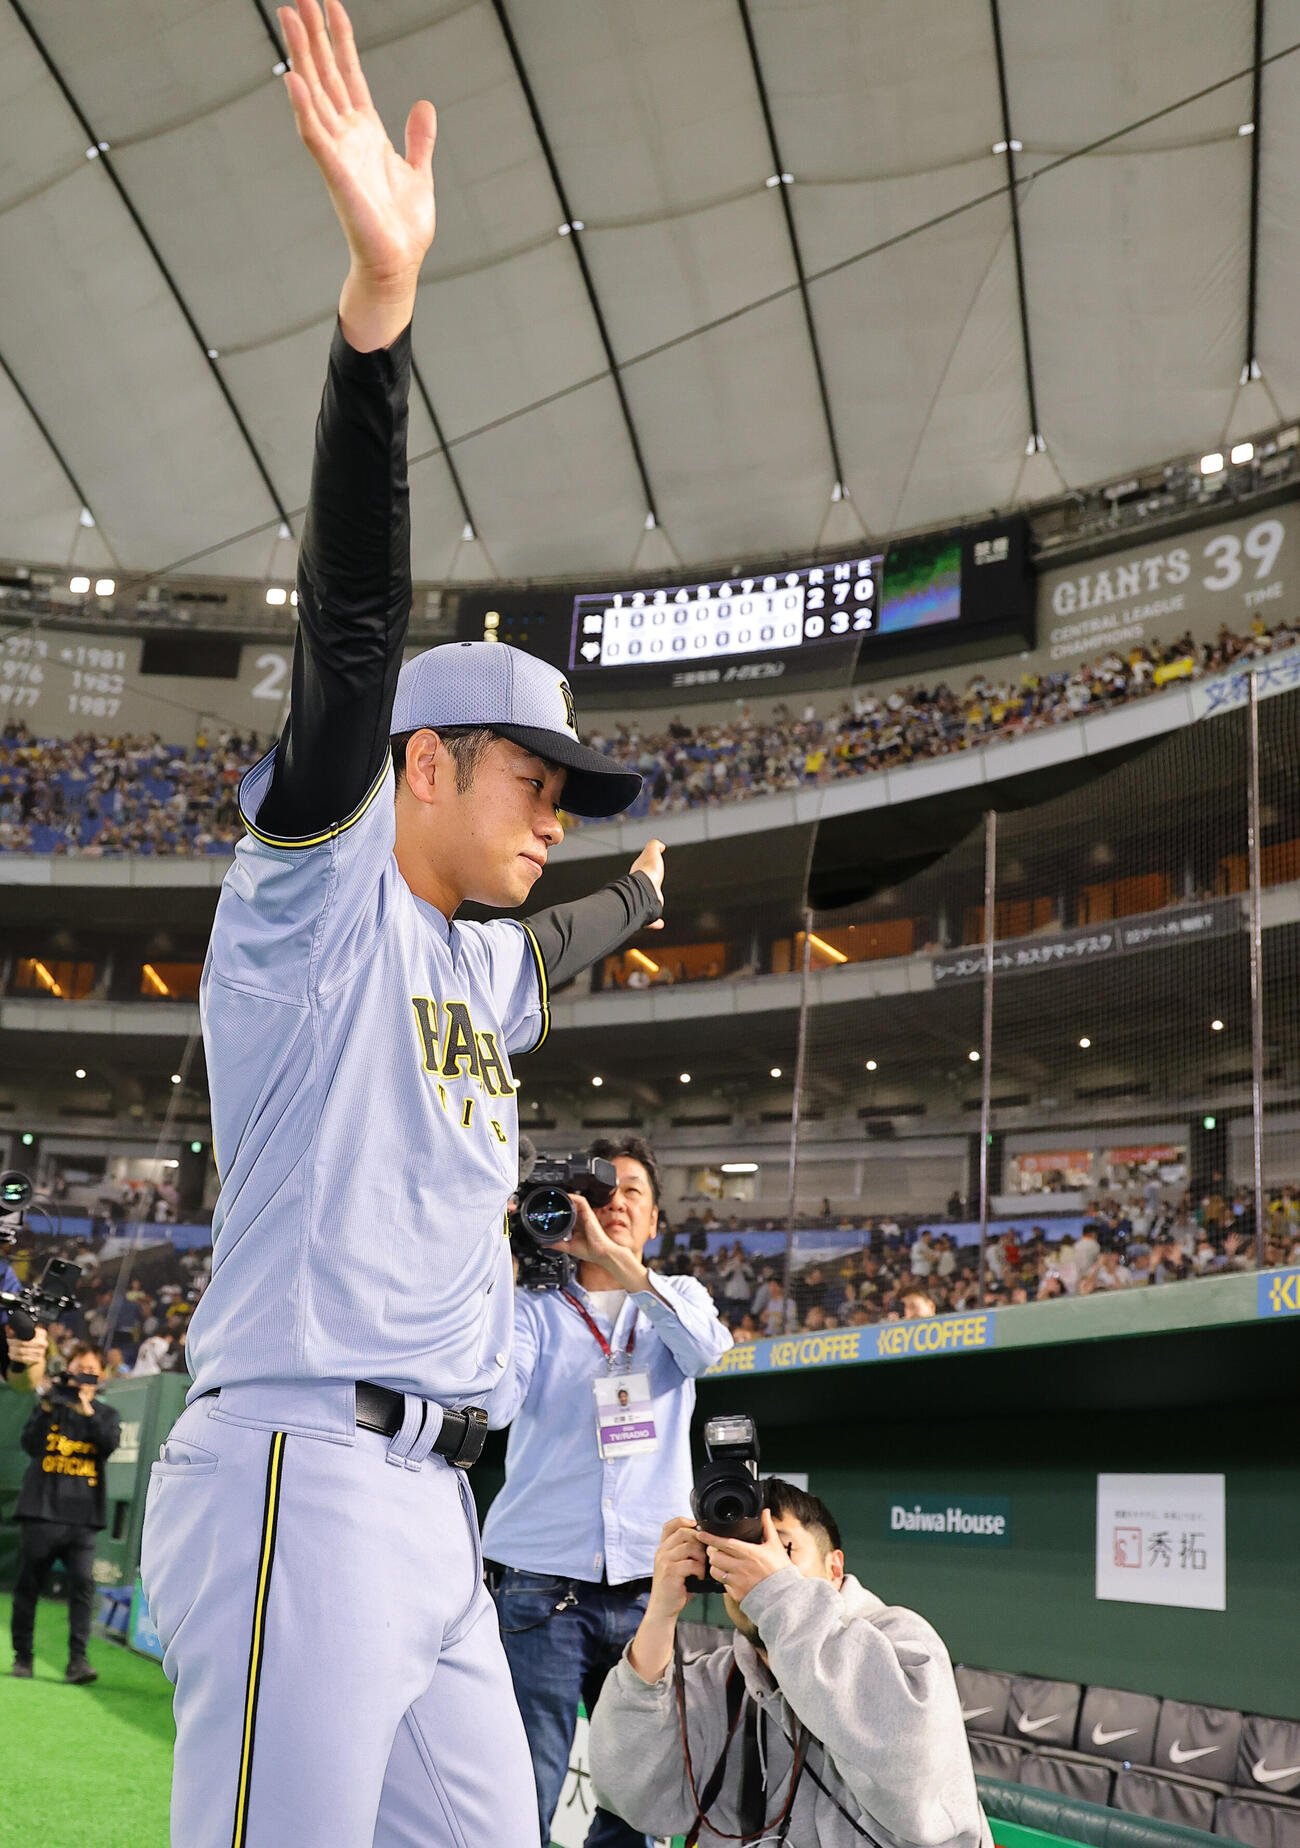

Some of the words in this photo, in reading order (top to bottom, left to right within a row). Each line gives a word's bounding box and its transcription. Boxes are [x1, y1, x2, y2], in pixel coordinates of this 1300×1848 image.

[613, 594, 623, 608] 1
[632, 592, 646, 608] 2
[654, 590, 667, 606] 3
[718, 582, 733, 598] 6
[741, 579, 754, 594] 7
[763, 576, 777, 592] 8
[785, 573, 799, 588] 9
[809, 568, 824, 585] R
[834, 563, 850, 581] H
[857, 559, 872, 577] E
[1052, 548, 1191, 617] GIANTS
[1203, 519, 1286, 591] 39
[613, 615, 619, 629] 1
[630, 612, 644, 628] 0
[652, 611, 666, 626] 0
[674, 608, 688, 624] 0
[696, 606, 709, 621] 0
[717, 603, 732, 619] 0
[740, 601, 753, 615] 0
[766, 598, 773, 612] 1
[784, 595, 798, 610] 0
[806, 587, 825, 610] 2
[832, 582, 850, 605] 7
[854, 578, 874, 601] 0
[1243, 580, 1284, 608] TIME
[607, 643, 620, 657] 0
[628, 640, 642, 656] 0
[650, 638, 663, 653] 0
[672, 636, 686, 652] 0
[694, 634, 707, 649] 0
[715, 631, 730, 647] 0
[738, 628, 751, 644] 0
[760, 625, 774, 641] 0
[783, 622, 796, 638] 0
[804, 615, 824, 638] 0
[830, 611, 850, 634] 3
[853, 607, 873, 631] 2
[1049, 613, 1119, 644] CENTRAL
[1122, 594, 1185, 625] LEAGUE
[1049, 623, 1145, 661] CHAMPIONS
[0, 684, 40, 708] 977
[2, 660, 44, 685] 976
[252, 653, 292, 701] 2
